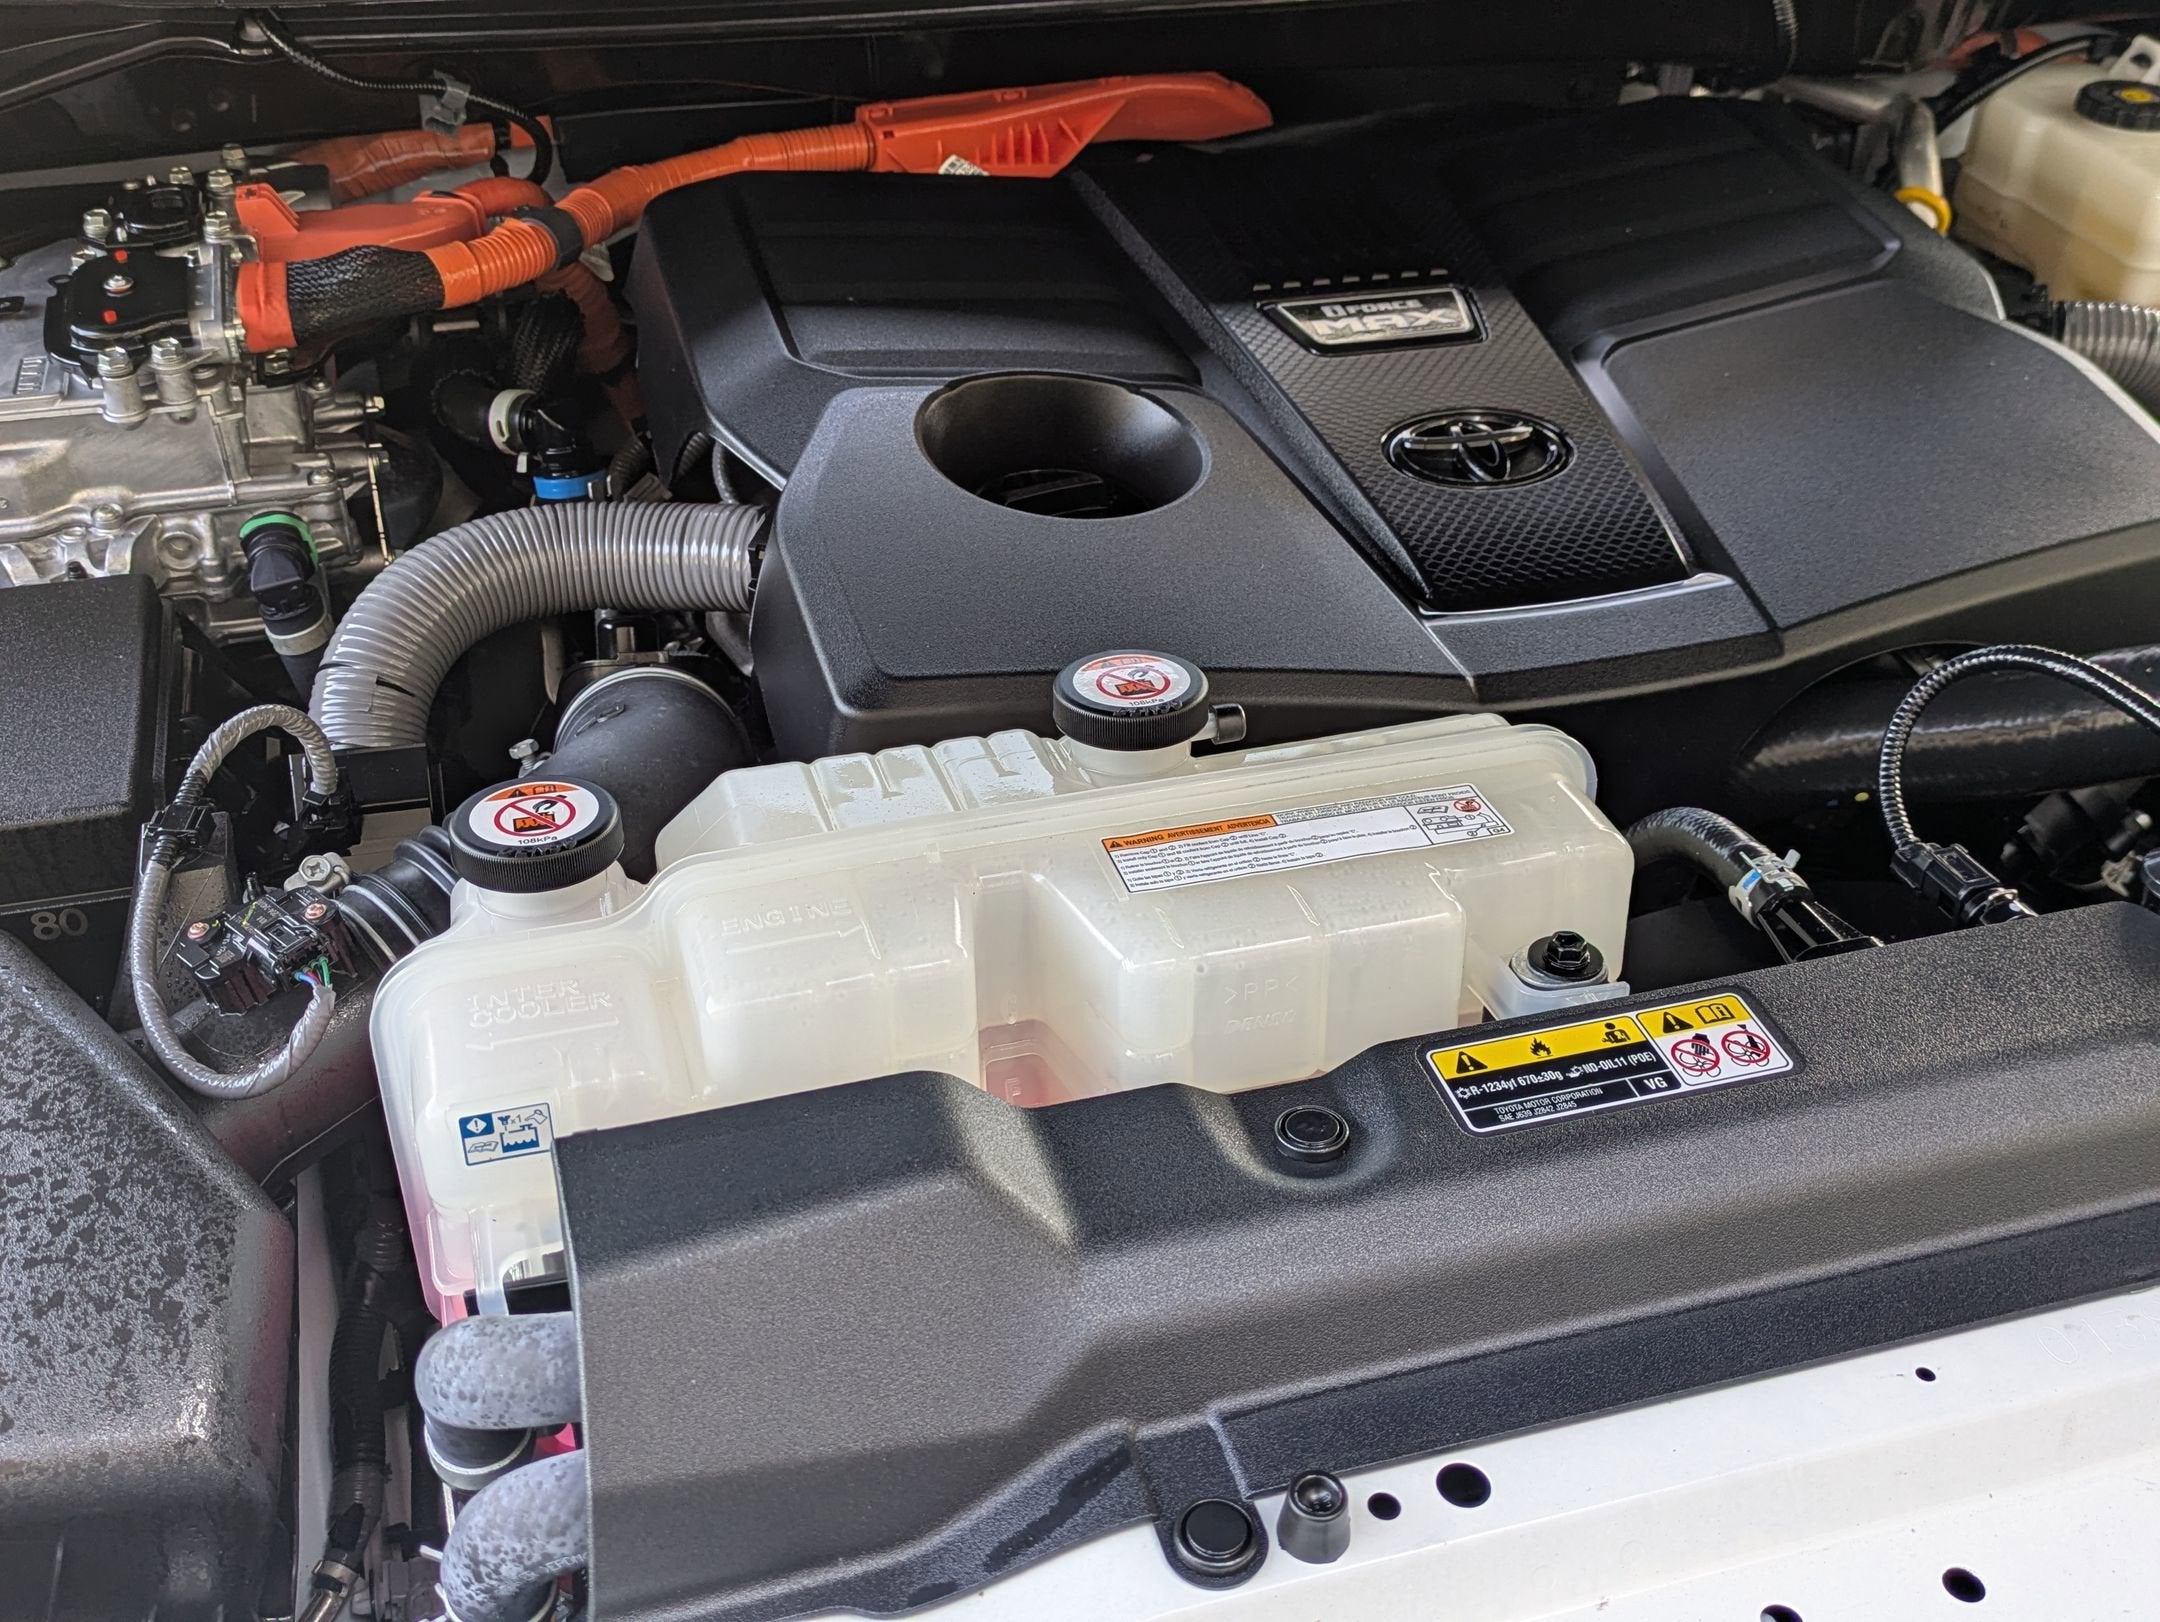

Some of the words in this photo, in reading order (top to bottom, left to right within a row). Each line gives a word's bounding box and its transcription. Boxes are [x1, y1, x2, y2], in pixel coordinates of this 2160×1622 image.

[1311, 308, 1457, 335] MAX
[517, 835, 558, 845] 108kPa
[1123, 833, 1164, 847] WARNING
[1167, 824, 1223, 839] AVERTISSEMENT
[1227, 818, 1271, 830] ADVERTENCIA
[31, 908, 88, 940] 80
[721, 900, 851, 936] ENGINE
[468, 979, 578, 1012] INTER
[470, 991, 613, 1027] COOLER
[1581, 1056, 1628, 1074] ND-OIL11
[1628, 1051, 1656, 1066] (POE)
[1470, 1078, 1518, 1096] R-1234yf
[1518, 1070, 1563, 1086] 670±30g
[1643, 1076, 1668, 1090] VG
[1494, 1105, 1523, 1115] TOYOTA
[1523, 1097, 1551, 1109] MOTOR
[1551, 1087, 1604, 1104] CORPORATION
[1498, 1114, 1515, 1122] SAE
[1515, 1109, 1533, 1119] J639
[1534, 1105, 1555, 1116] J2842
[1556, 1101, 1578, 1111] J2845
